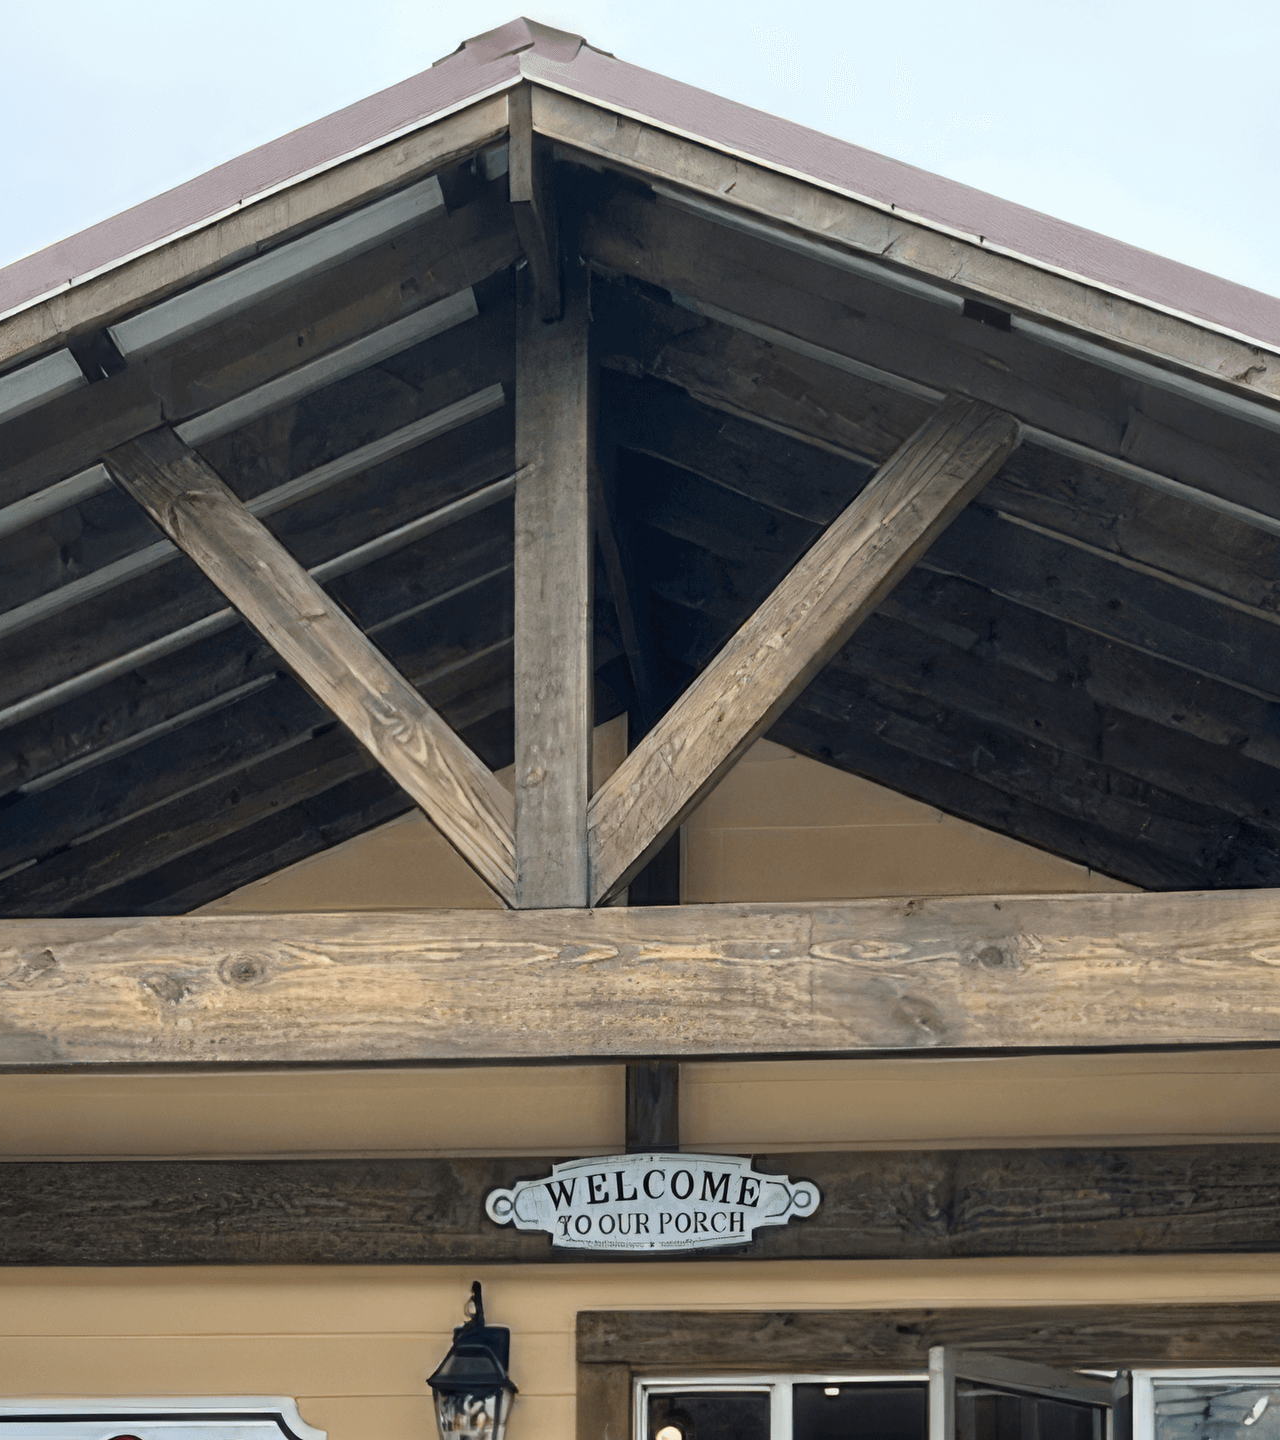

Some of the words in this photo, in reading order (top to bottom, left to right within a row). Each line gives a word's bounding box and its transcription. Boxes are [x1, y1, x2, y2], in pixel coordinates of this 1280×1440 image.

[543, 1168, 762, 1212] WELCOME
[598, 1212, 650, 1235] OUR
[658, 1210, 746, 1235] PORCH
